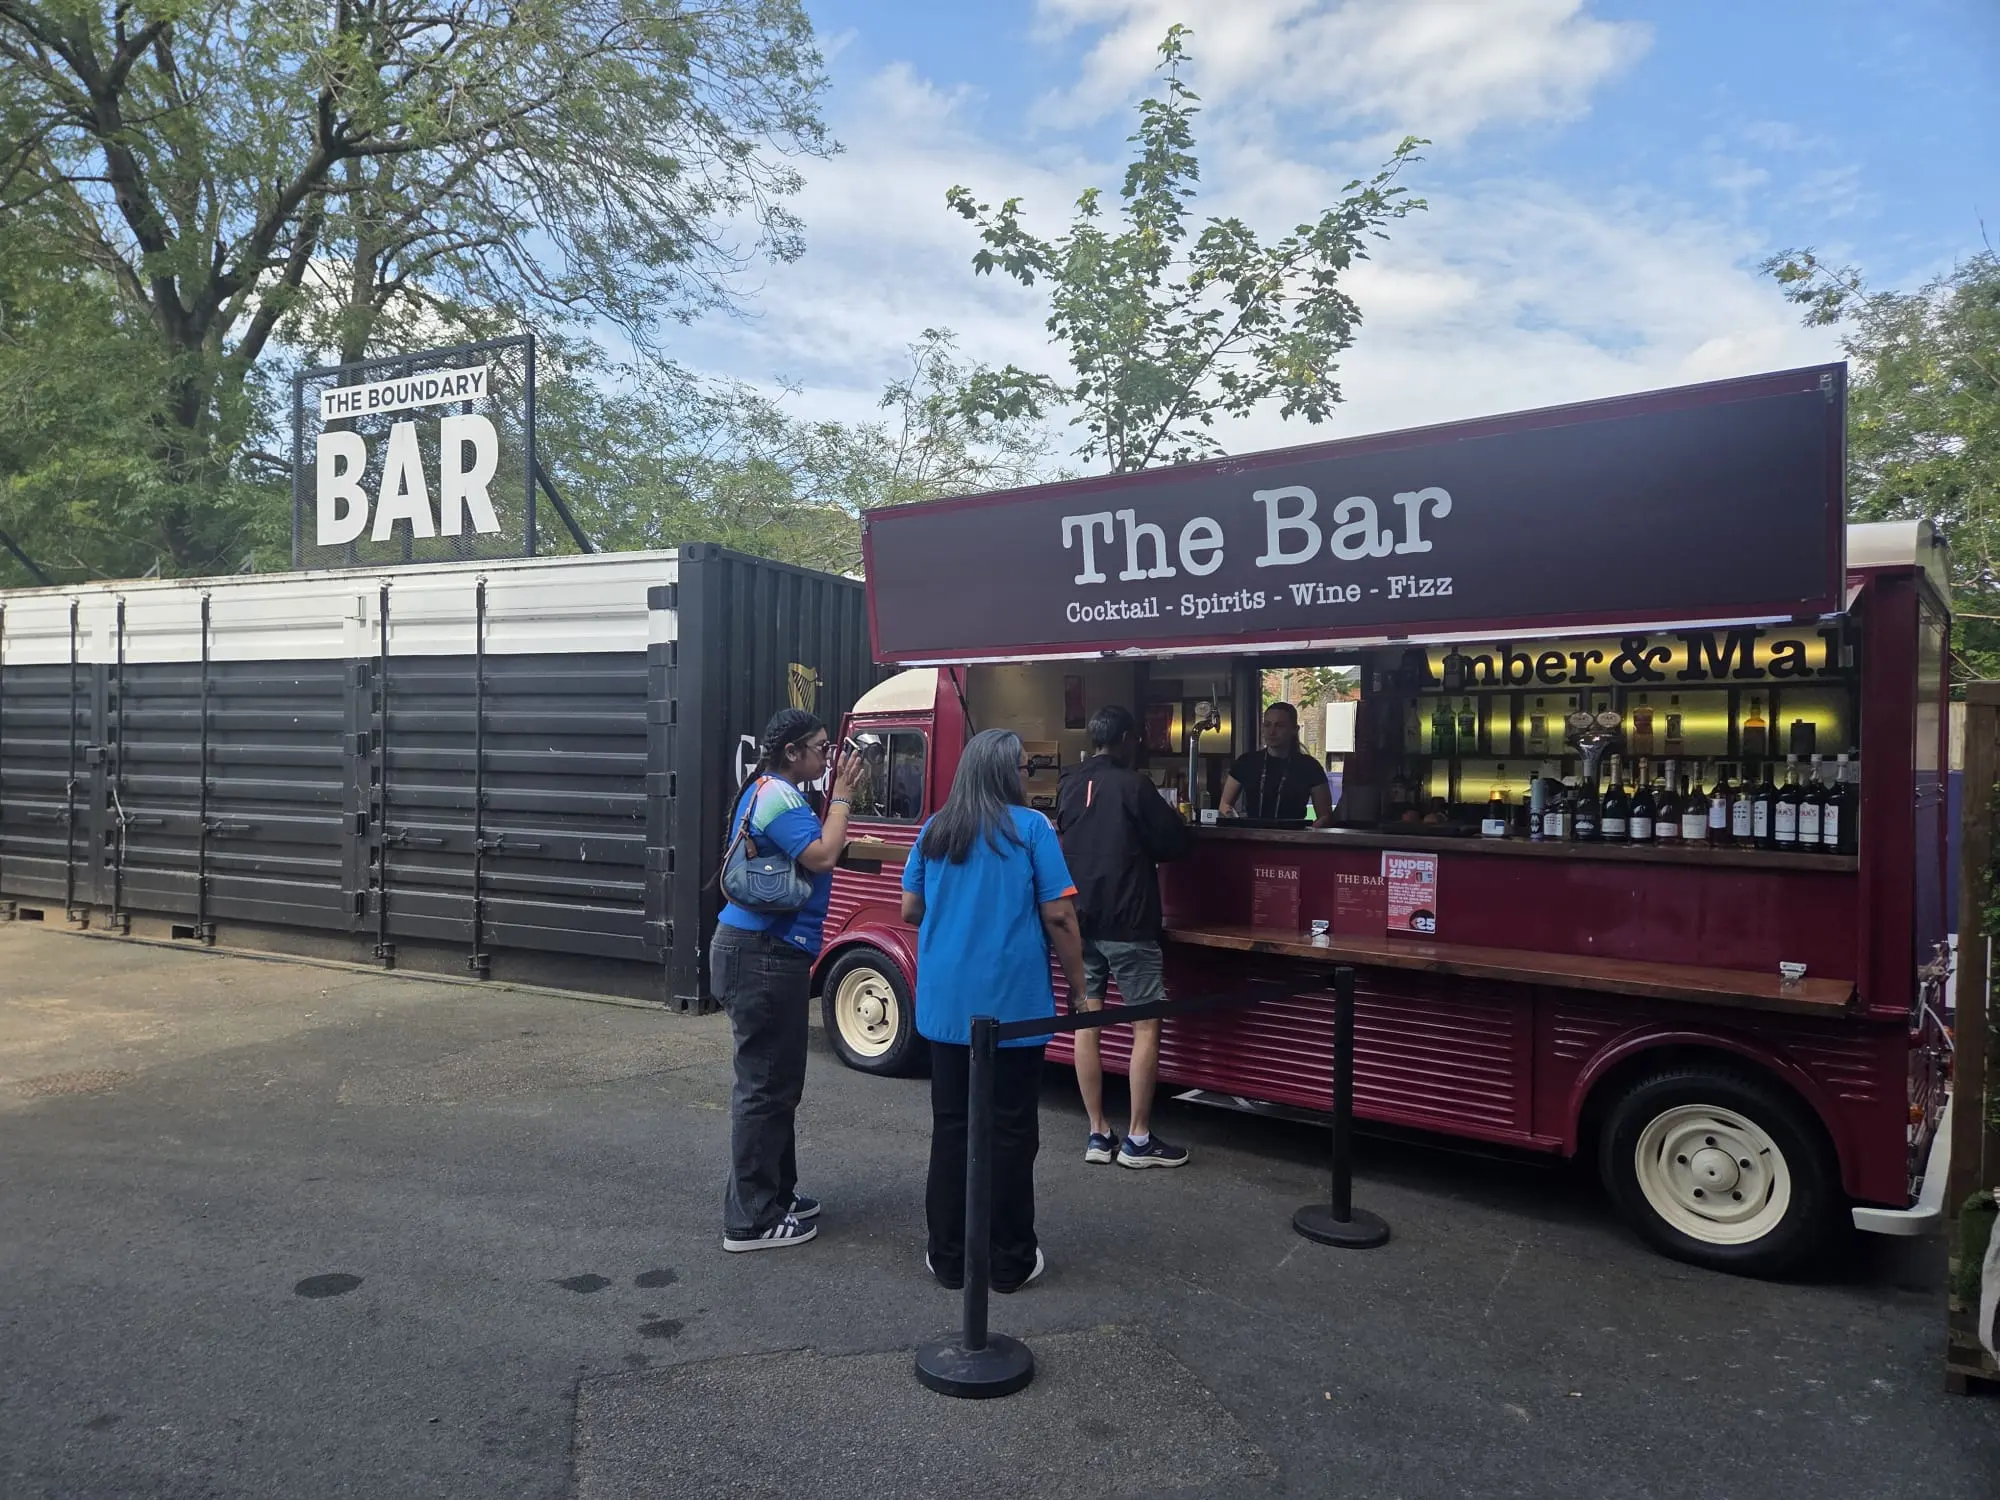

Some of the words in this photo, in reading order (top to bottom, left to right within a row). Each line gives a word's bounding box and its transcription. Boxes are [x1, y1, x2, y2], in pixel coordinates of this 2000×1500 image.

[325, 391, 362, 414] THE
[368, 371, 484, 408] BOUNDARY
[317, 414, 501, 546] BAR
[1062, 509, 1225, 586] The
[1252, 485, 1453, 568] Bar
[1066, 597, 1159, 623] Cocktail
[1180, 589, 1266, 620] Spirits
[1289, 581, 1361, 606] Wine
[1387, 575, 1453, 600] Fizz
[1388, 858, 1434, 871] UNDER
[1254, 868, 1276, 879] THE
[1278, 870, 1299, 880] BAR
[1336, 873, 1360, 885] THE
[1363, 875, 1385, 886] BAR
[1389, 868, 1411, 879] 25?
[1416, 917, 1435, 931] 25
